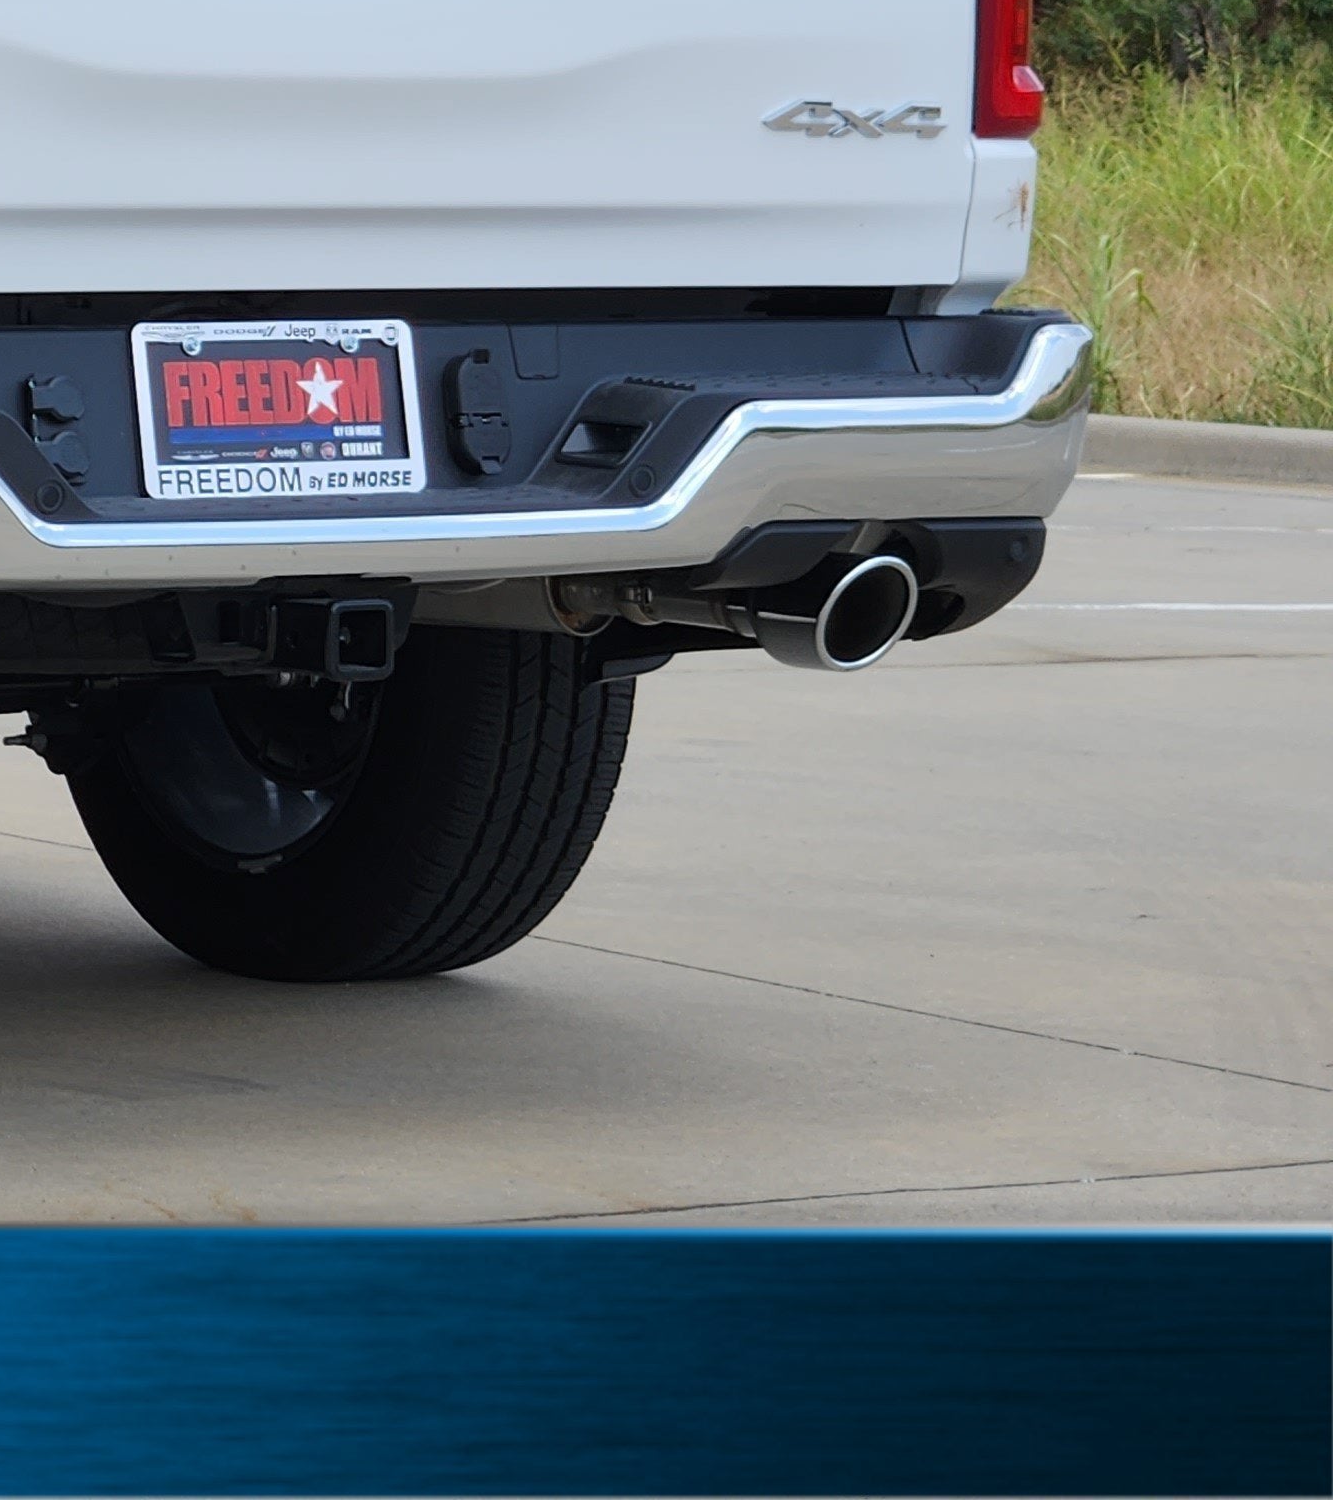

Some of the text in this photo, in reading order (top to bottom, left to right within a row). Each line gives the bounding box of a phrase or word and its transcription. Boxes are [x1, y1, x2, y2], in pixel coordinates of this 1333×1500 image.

[761, 100, 949, 138] 4x4
[284, 323, 316, 339] Jeep
[162, 357, 382, 427] FREEDOM
[158, 466, 303, 495] FREEDOM
[327, 472, 349, 489] ED
[352, 470, 413, 489] MORSE
